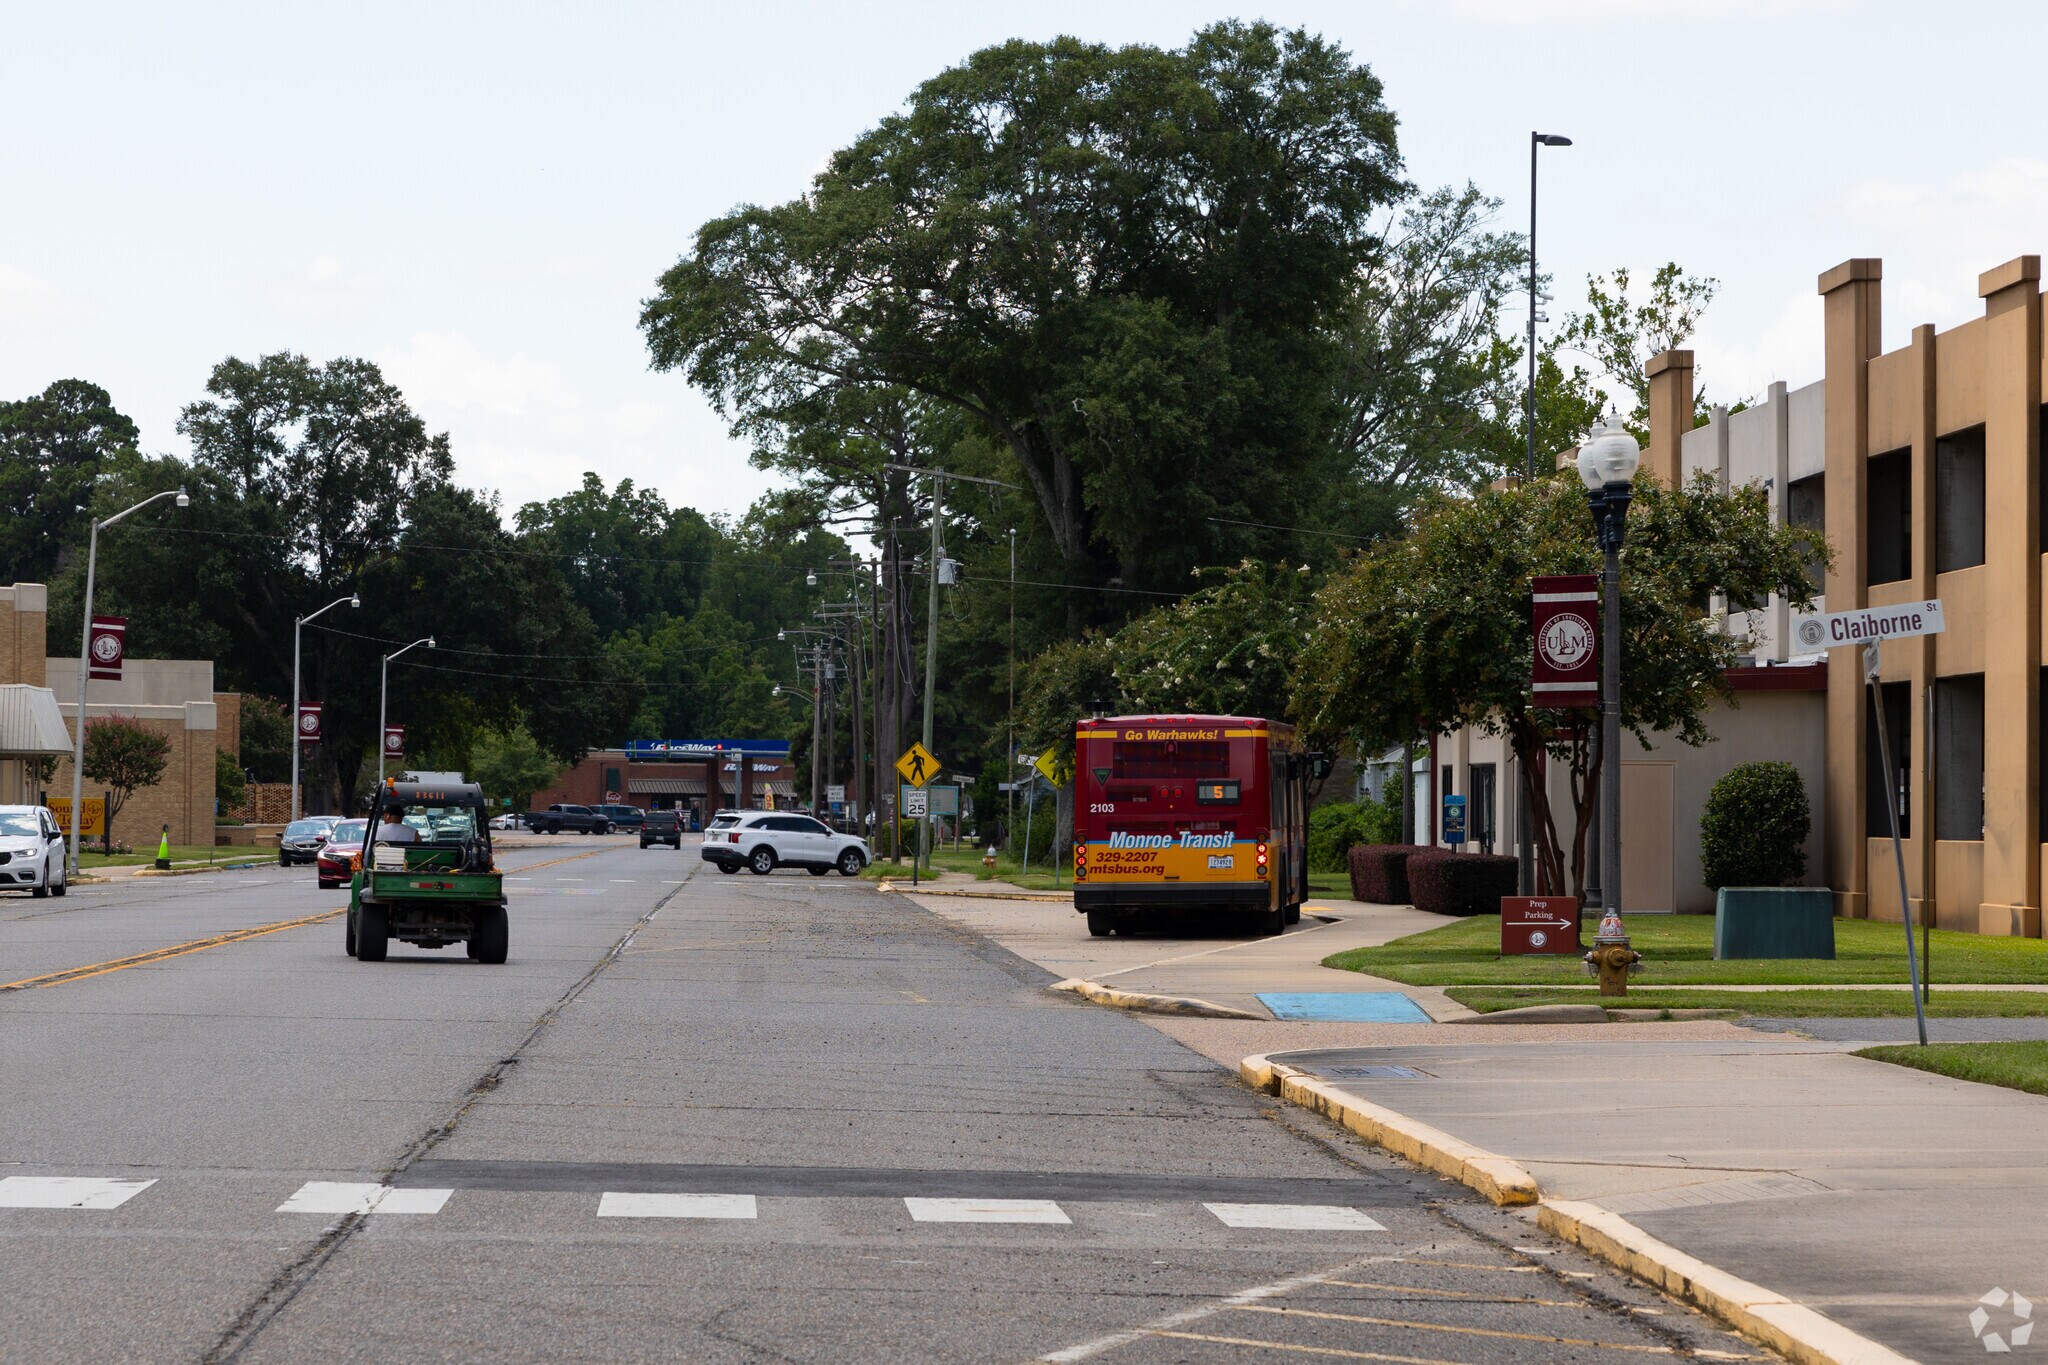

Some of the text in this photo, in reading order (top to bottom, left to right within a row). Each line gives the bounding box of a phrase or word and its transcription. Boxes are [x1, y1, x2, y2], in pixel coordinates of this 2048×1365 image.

[1830, 613, 1922, 641] Claiborne
[1926, 602, 1937, 612] St
[1541, 622, 1553, 652] UNIVERSITY
[1562, 615, 1587, 629] LOUISIANA
[1547, 627, 1586, 656] ULM
[1125, 729, 1218, 741] Go Warhawks!
[1213, 785, 1223, 799] 5
[48, 801, 87, 814] Soud
[909, 804, 925, 815] 25
[1090, 803, 1115, 813] 2103
[1109, 831, 1235, 849] Monroe Transit
[1096, 852, 1159, 863] 329-2207
[1089, 864, 1165, 876] mtsbus.org
[1530, 900, 1547, 908] Prep
[1525, 911, 1553, 920] Parking
